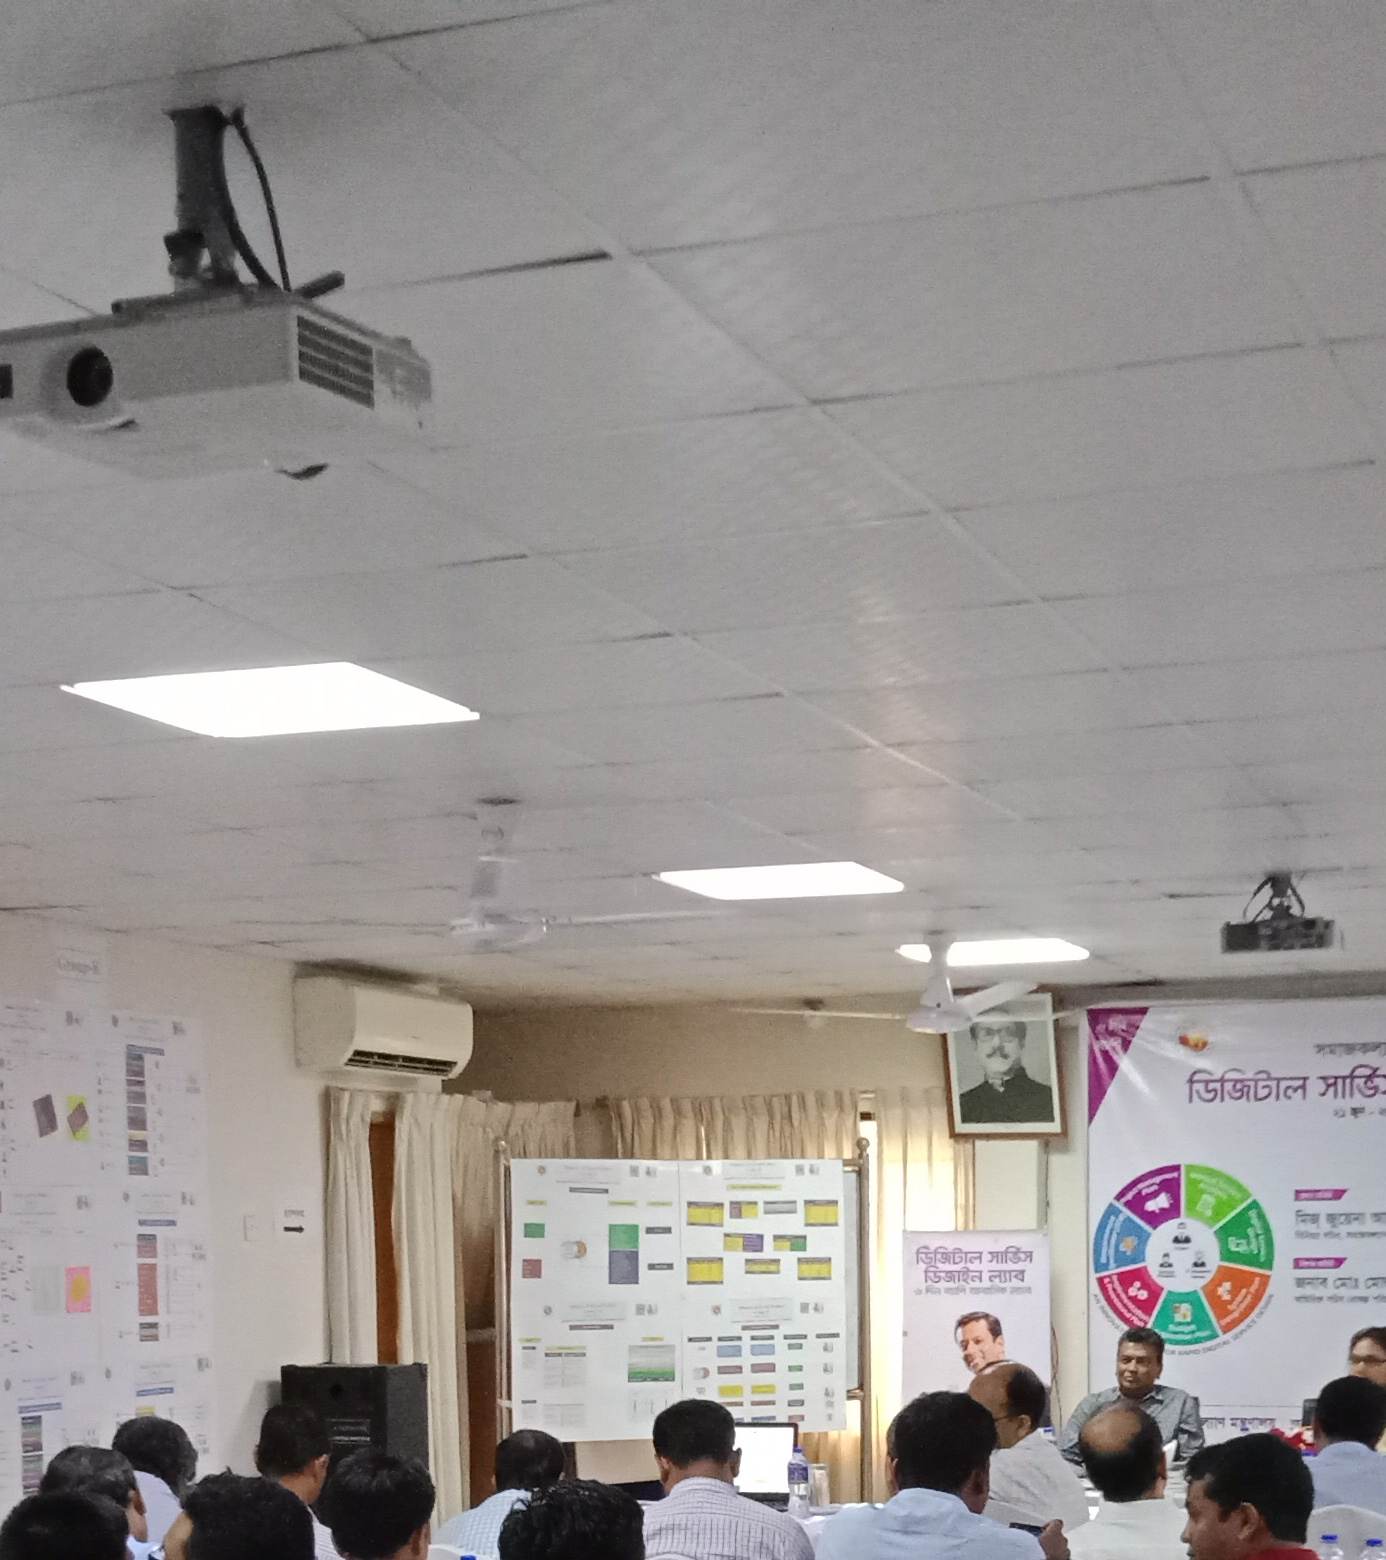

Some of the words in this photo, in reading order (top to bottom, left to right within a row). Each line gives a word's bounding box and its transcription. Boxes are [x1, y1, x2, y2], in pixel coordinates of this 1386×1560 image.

[1186, 1069, 1310, 1104] ডিজিটাল
[915, 1244, 984, 1265] ডিজিটাল
[987, 1245, 1034, 1264] সার্ভিস
[924, 1265, 984, 1285] ডিজাইন
[987, 1269, 1026, 1284] ল্যাব
